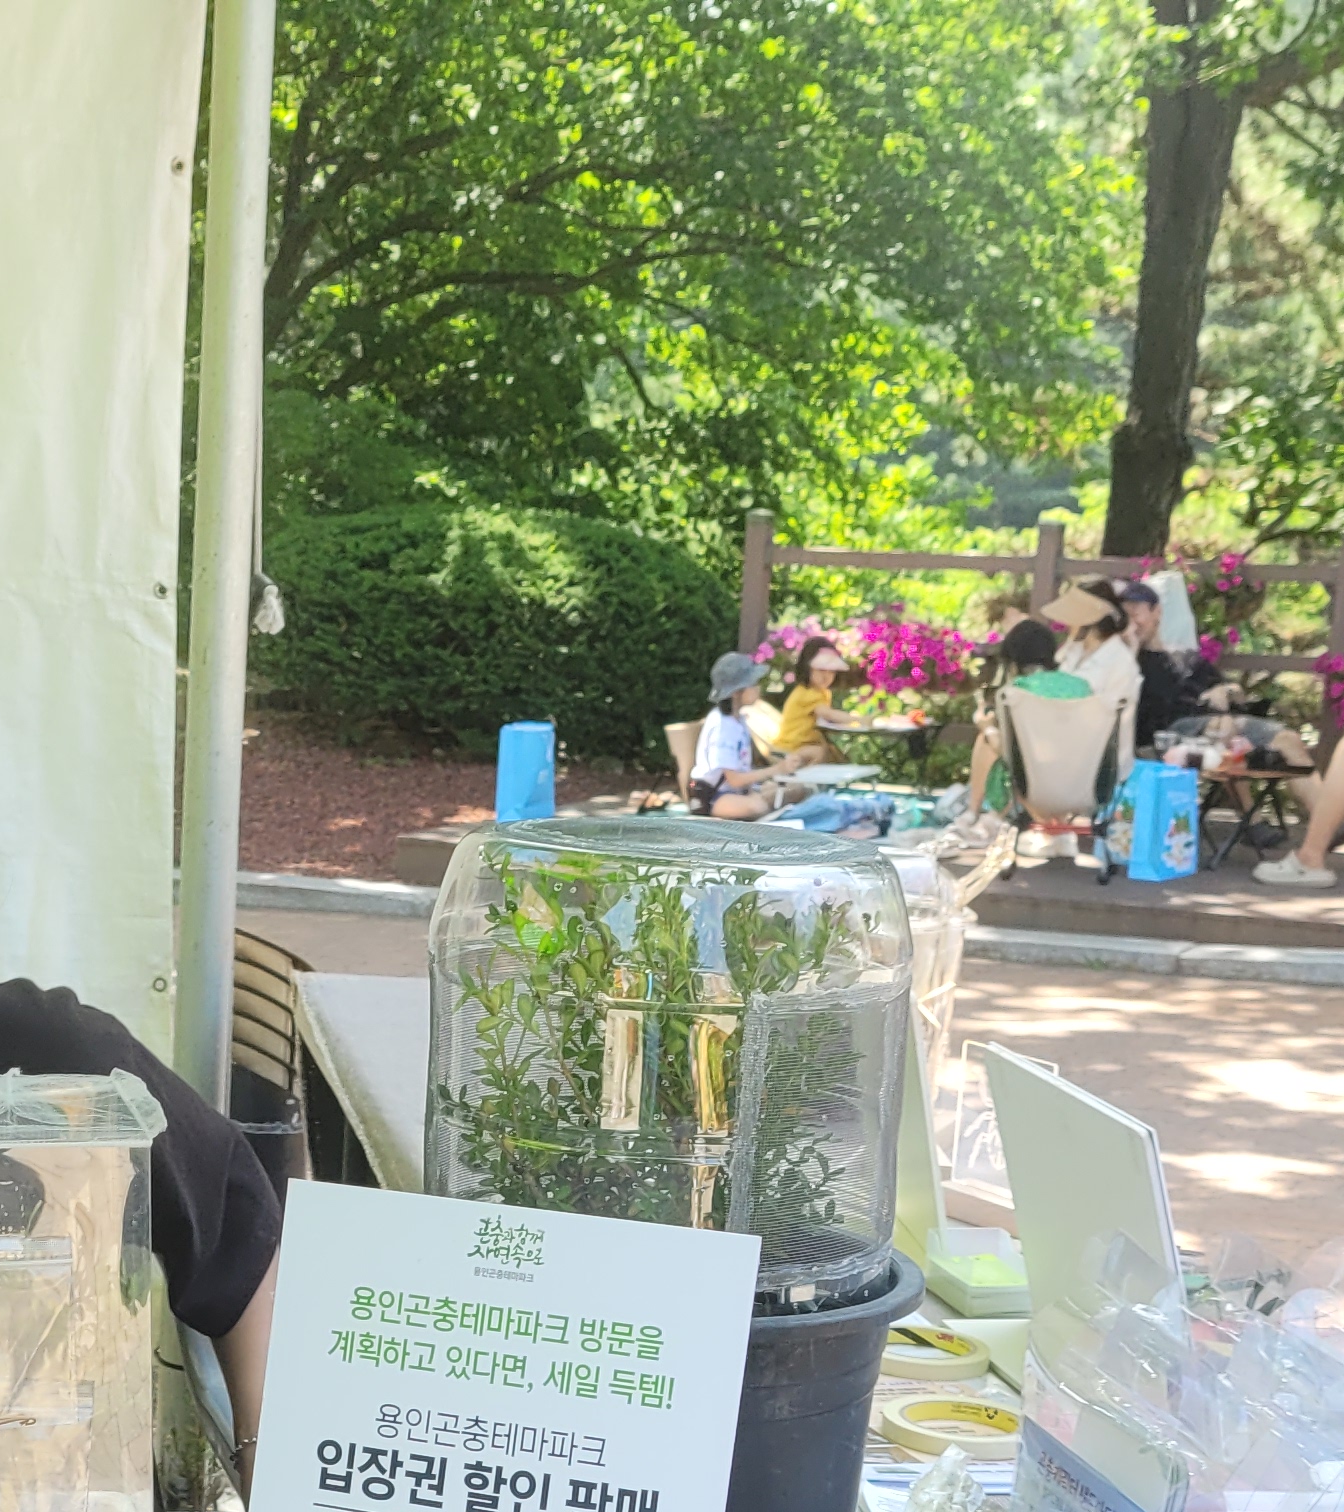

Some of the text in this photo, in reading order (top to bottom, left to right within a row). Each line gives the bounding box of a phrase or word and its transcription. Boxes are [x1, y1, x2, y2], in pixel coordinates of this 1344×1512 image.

[474, 1267, 534, 1282] 용인곤충테마파크
[350, 1286, 665, 1361] 용인곤충테마파크 방문을
[328, 1329, 675, 1410] 계획하고 있다면, 세일 득템!
[374, 1403, 606, 1467] 용인곤충테마파크
[316, 1439, 448, 1509] 입장권
